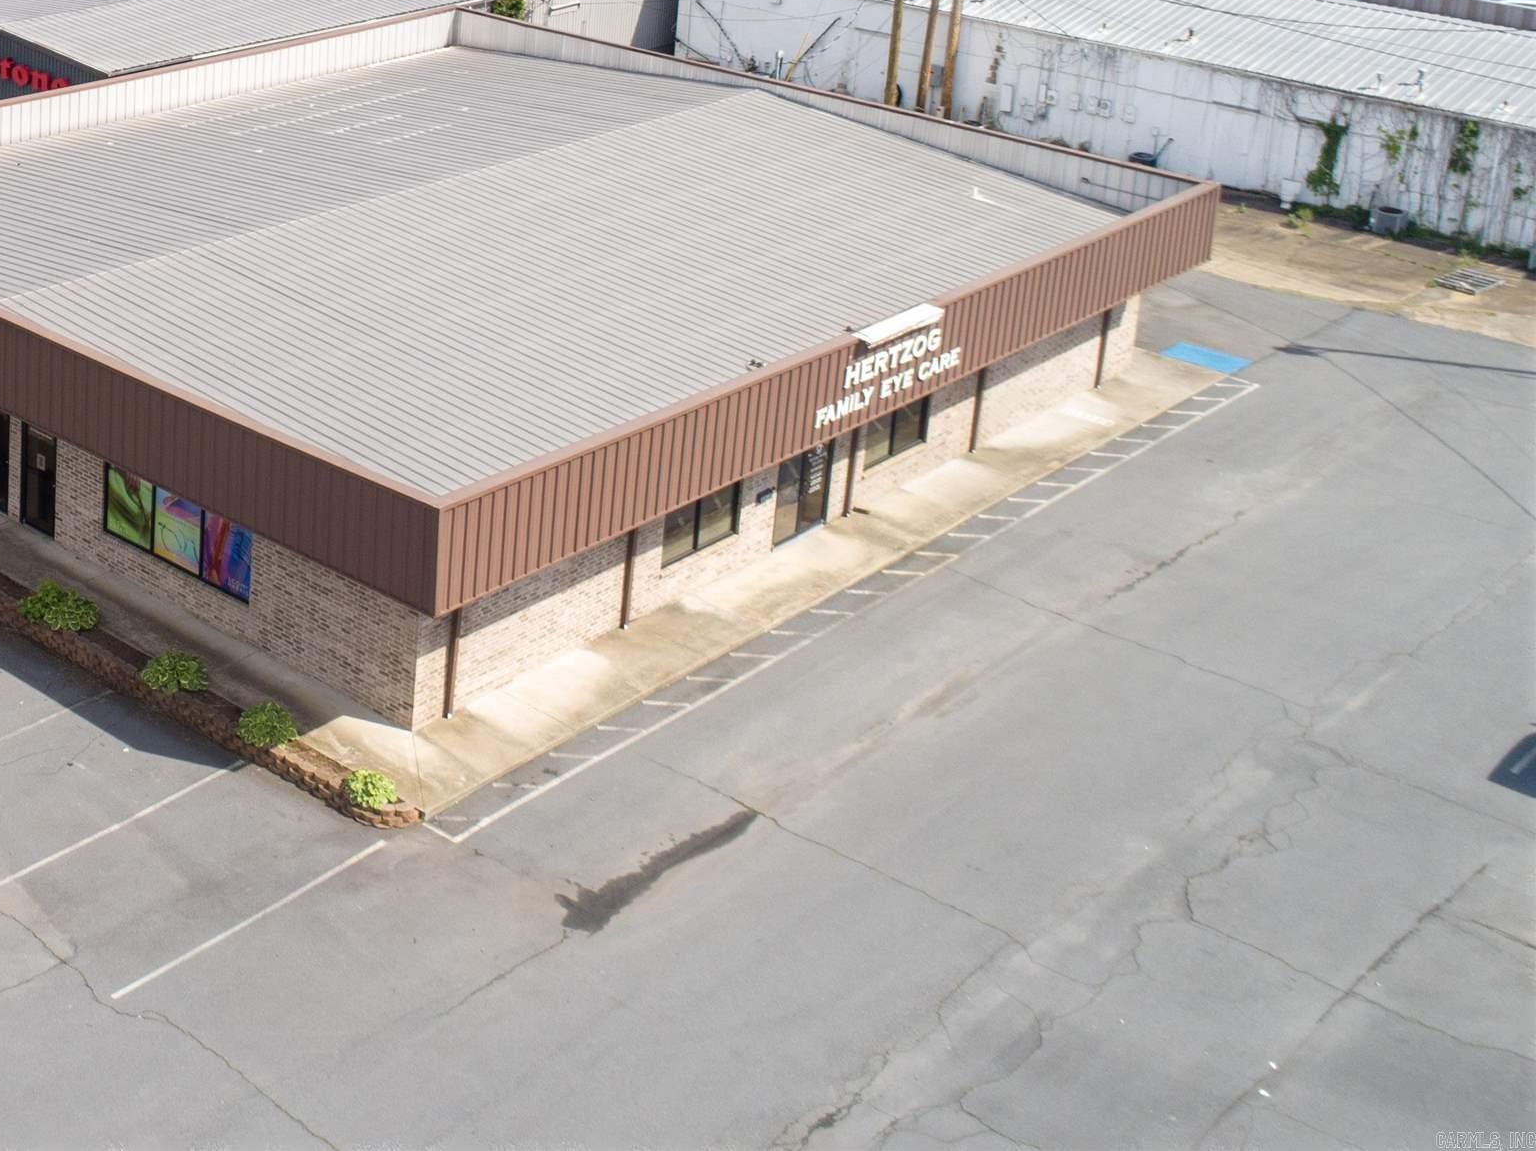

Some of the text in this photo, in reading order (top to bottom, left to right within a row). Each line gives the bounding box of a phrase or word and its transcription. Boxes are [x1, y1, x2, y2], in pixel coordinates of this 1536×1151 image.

[814, 347, 962, 429] FAMILY EYE CARE
[844, 328, 943, 390] HERTZOG
